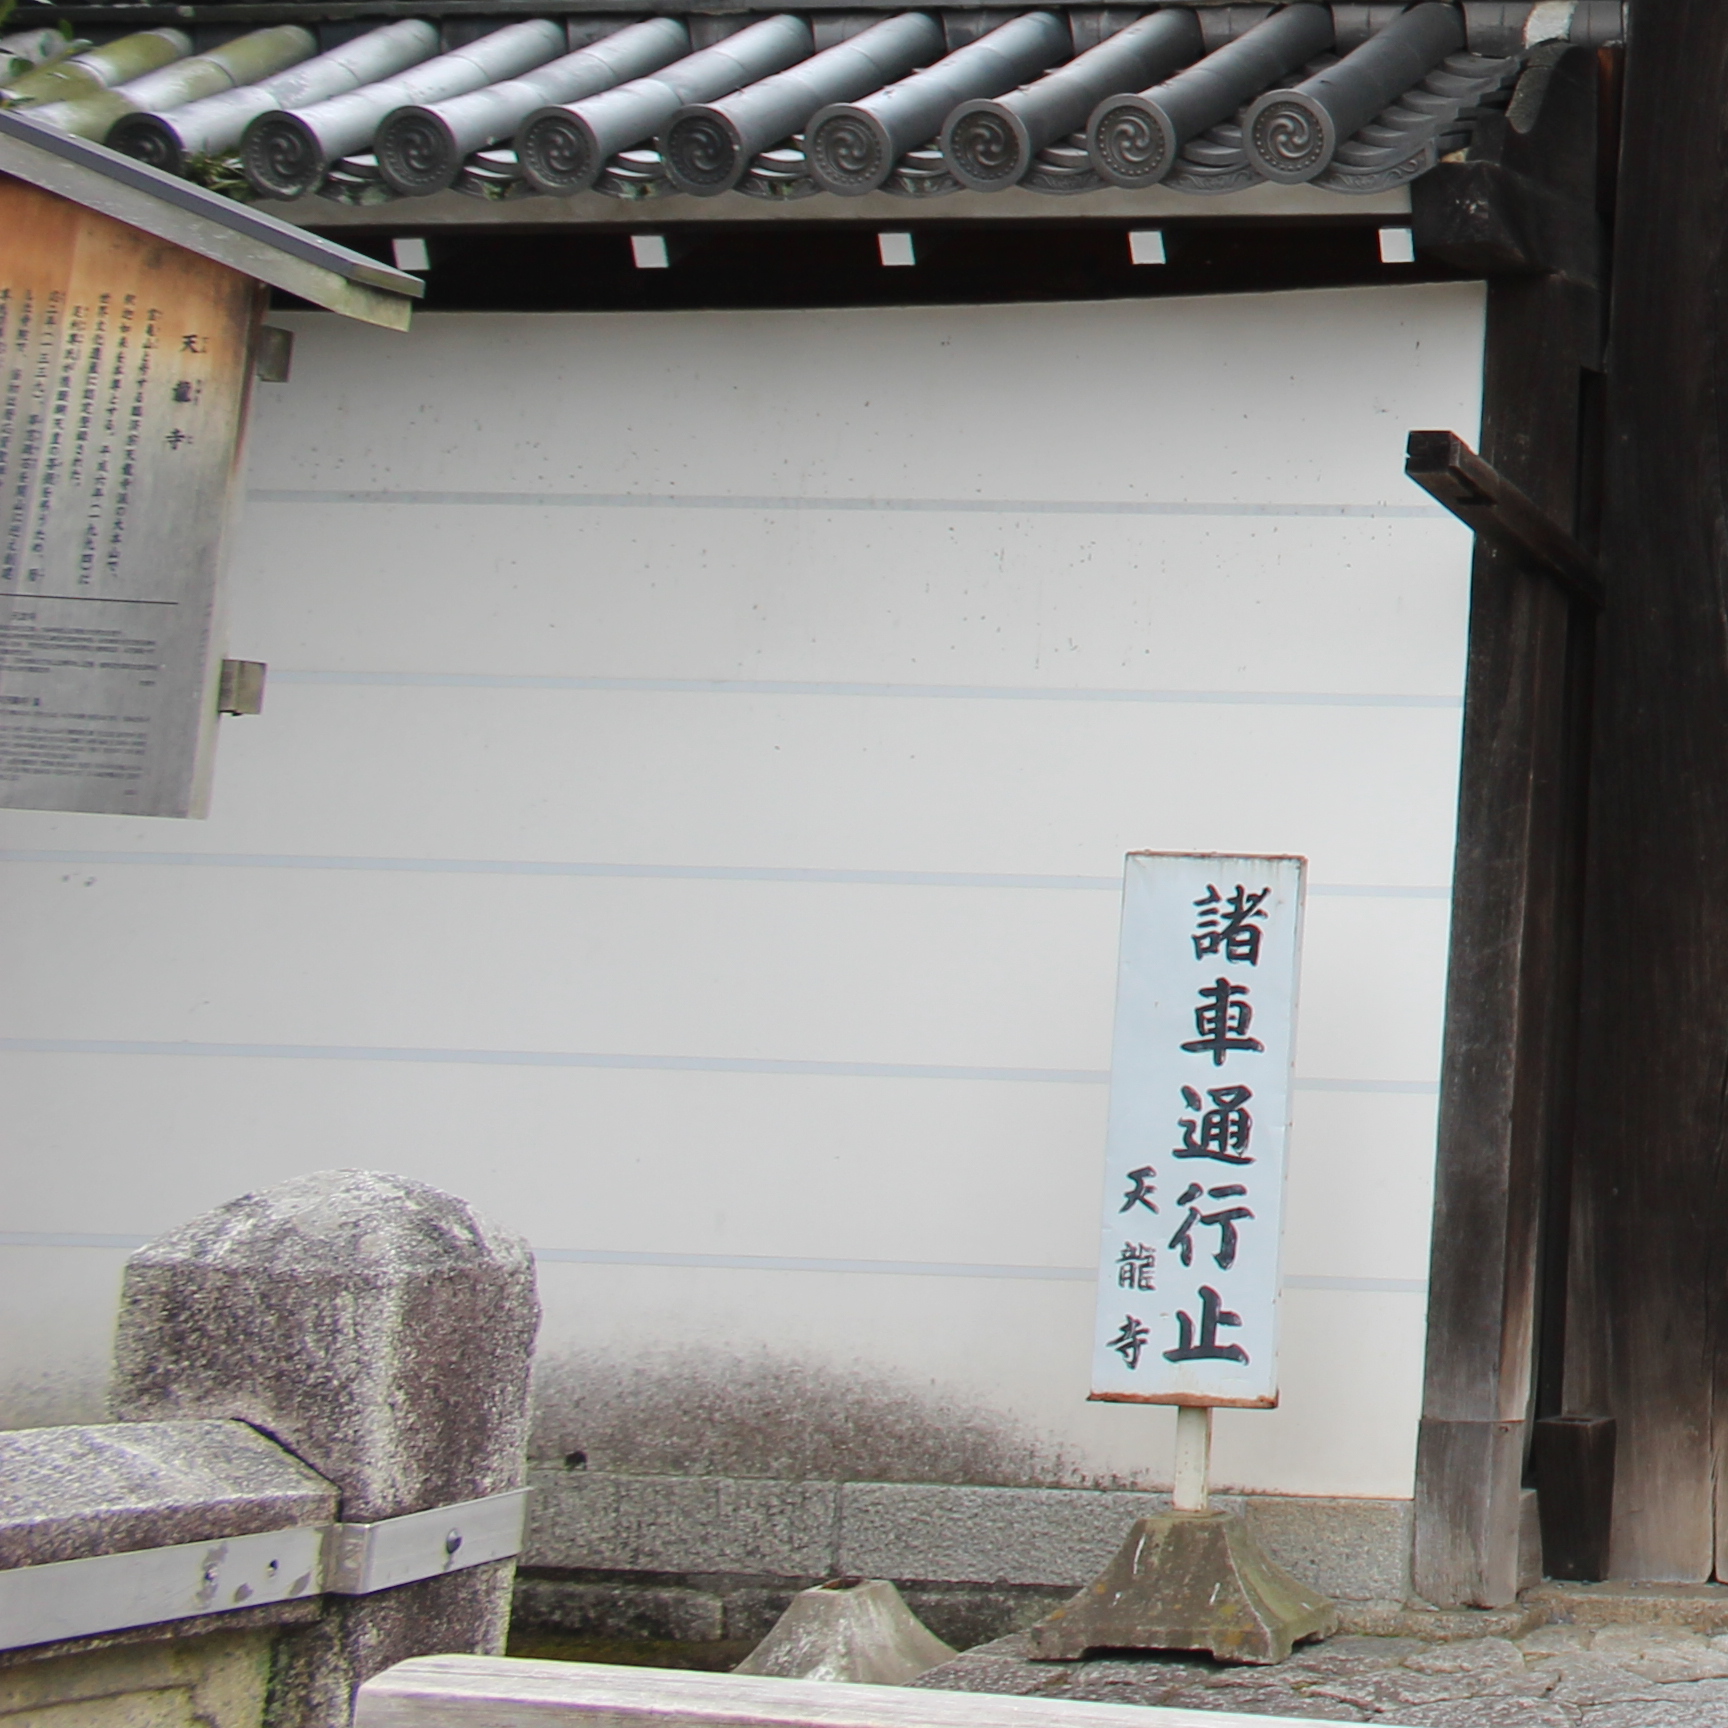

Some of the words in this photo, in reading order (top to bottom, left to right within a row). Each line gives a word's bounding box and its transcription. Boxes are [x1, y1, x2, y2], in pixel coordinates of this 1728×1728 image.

[165, 334, 199, 451] 天龍寺
[1162, 883, 1271, 1367] 諸車通行止
[1106, 1165, 1159, 1370] 天龍寺
